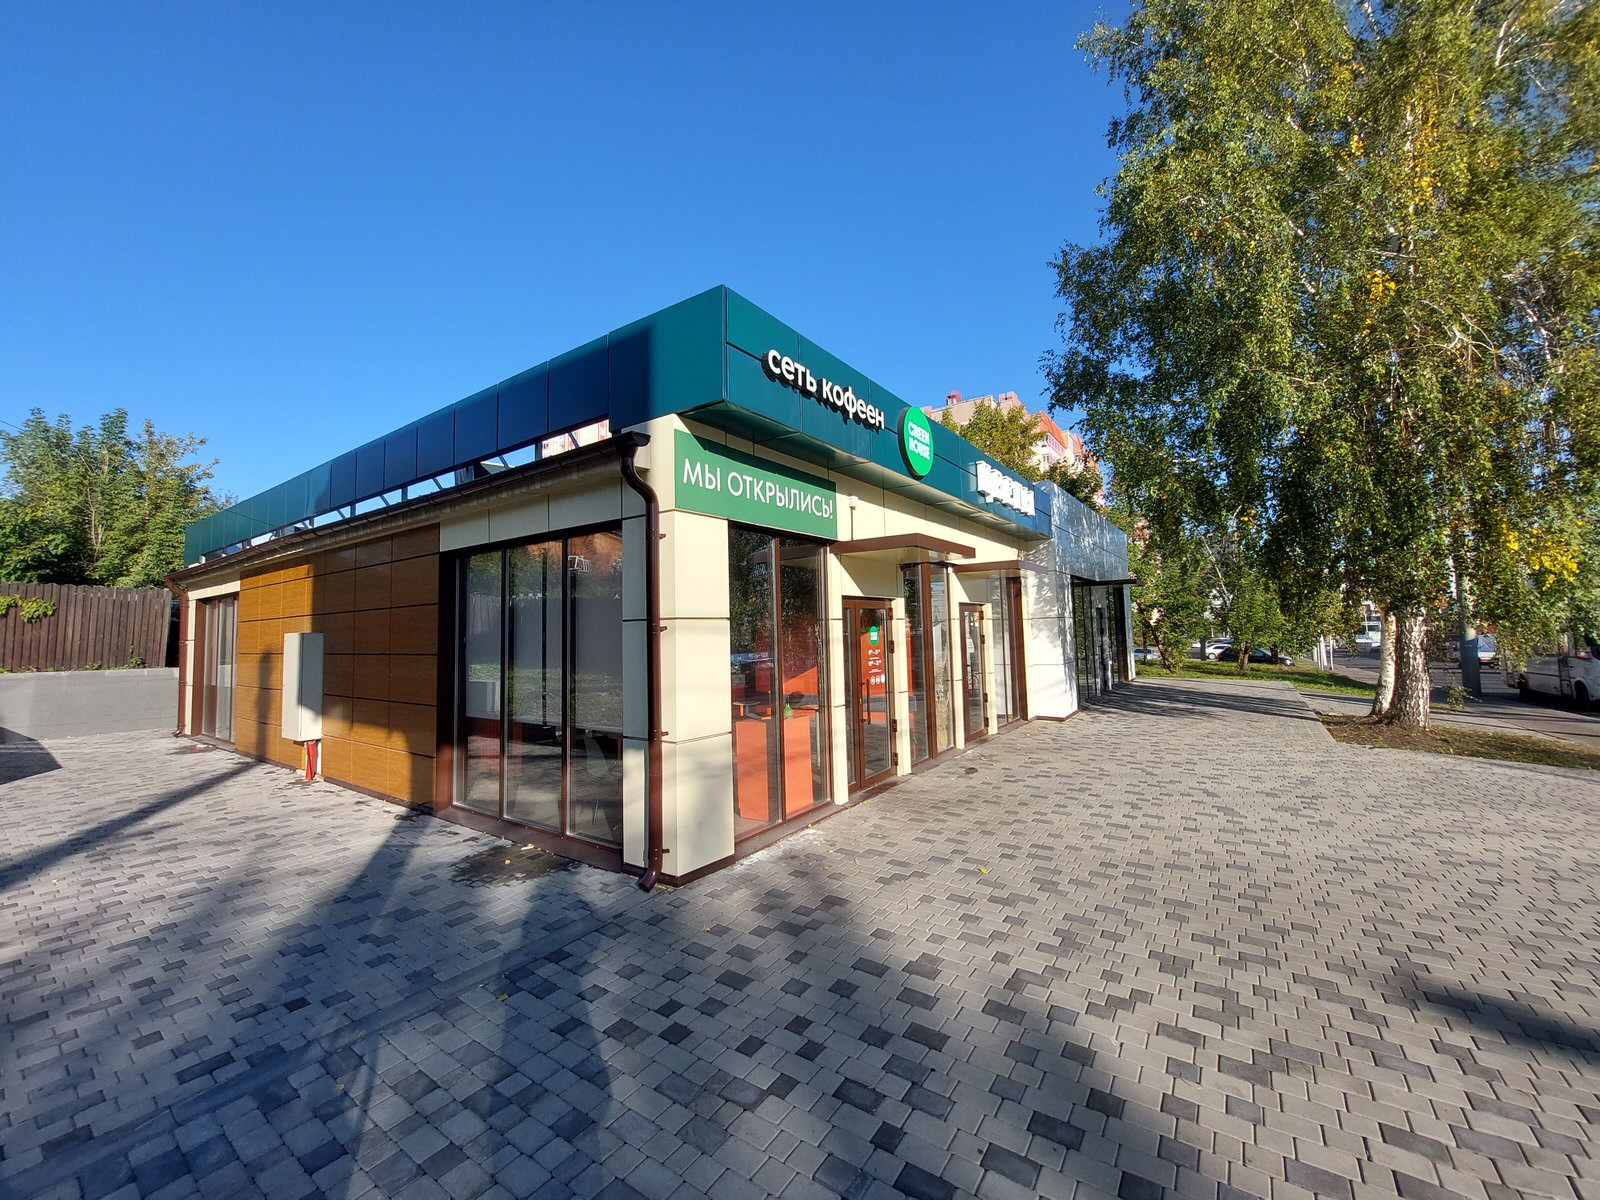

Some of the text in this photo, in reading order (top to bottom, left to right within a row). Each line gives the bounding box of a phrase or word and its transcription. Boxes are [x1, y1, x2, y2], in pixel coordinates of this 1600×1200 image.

[767, 349, 885, 429] сеть кофеен
[908, 421, 930, 446] GREEN
[908, 436, 931, 461] HOUSE
[683, 458, 834, 520] МЫ ОТКРЫЛИСЬ!
